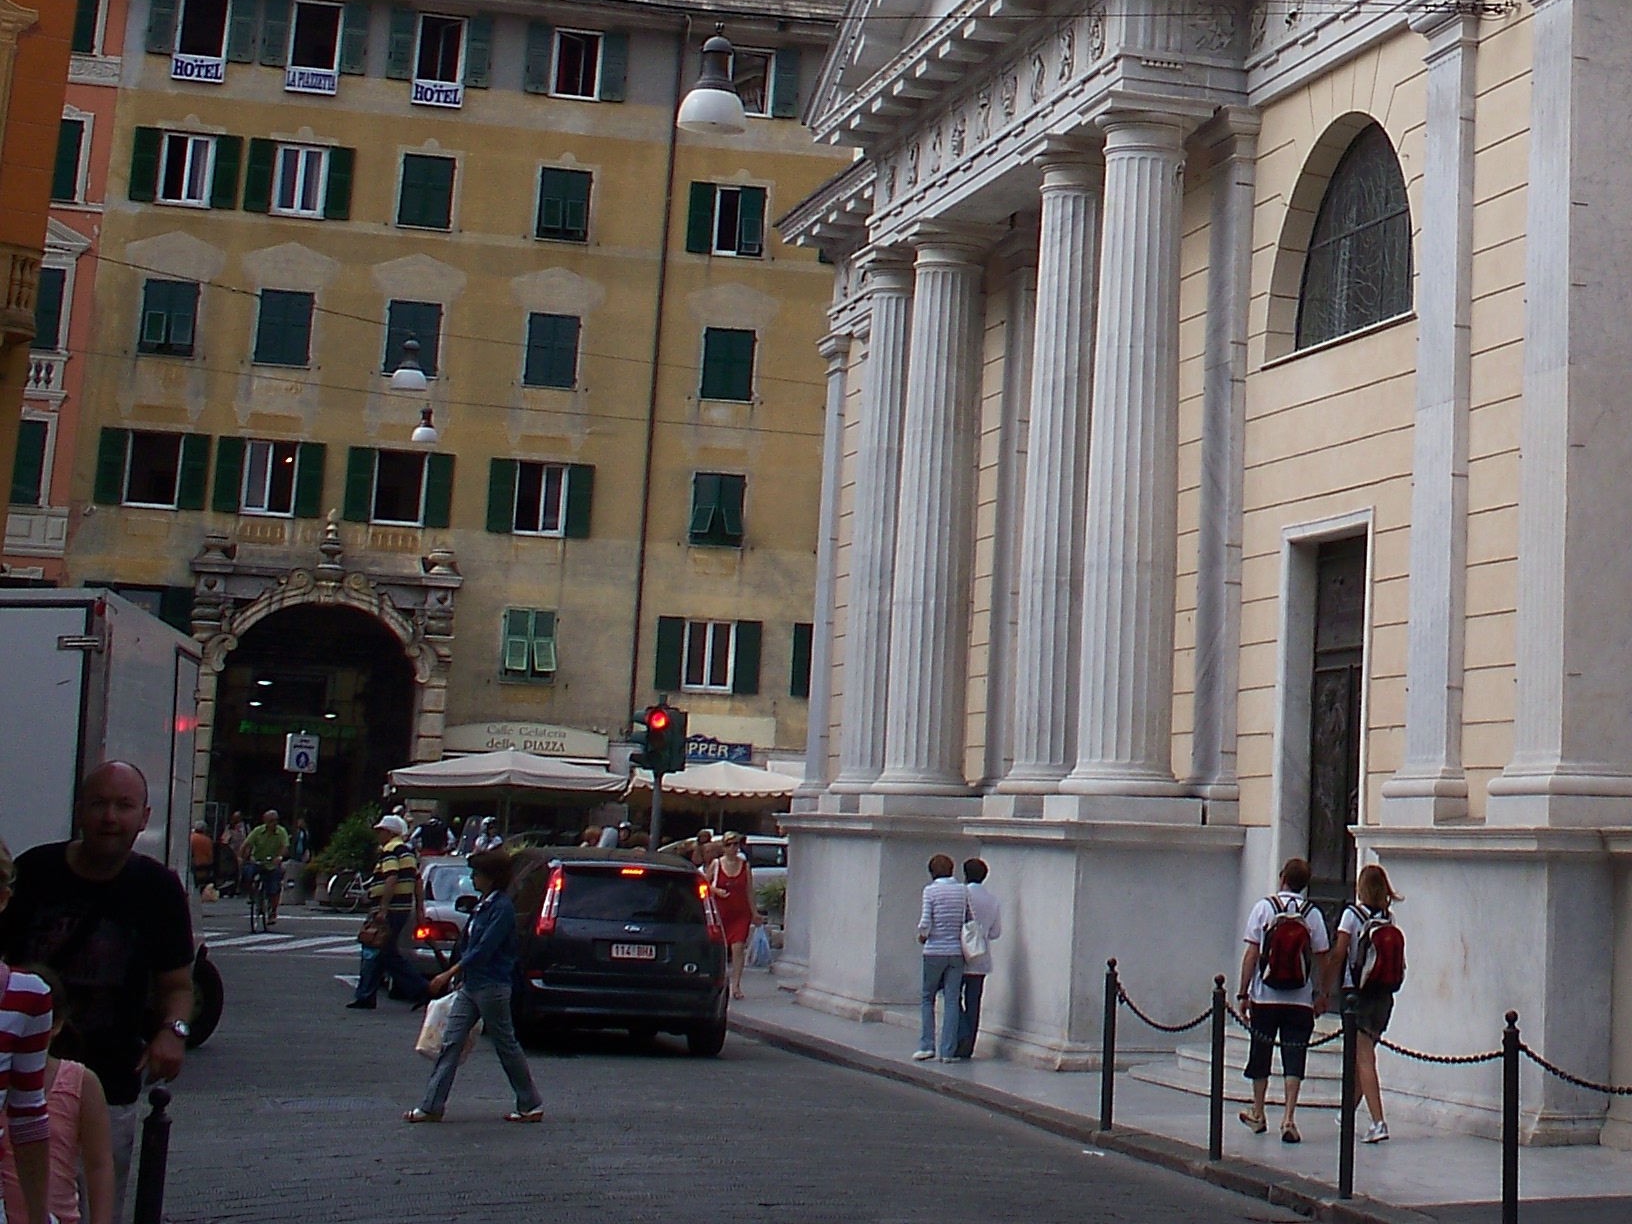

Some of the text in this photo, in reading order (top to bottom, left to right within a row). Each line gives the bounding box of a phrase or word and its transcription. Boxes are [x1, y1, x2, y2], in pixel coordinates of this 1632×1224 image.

[173, 58, 222, 80] HOTEL
[286, 70, 296, 87] LA
[414, 83, 461, 105] HOTEL
[519, 727, 567, 738] Gelateria
[486, 737, 566, 752] della PIAZZA
